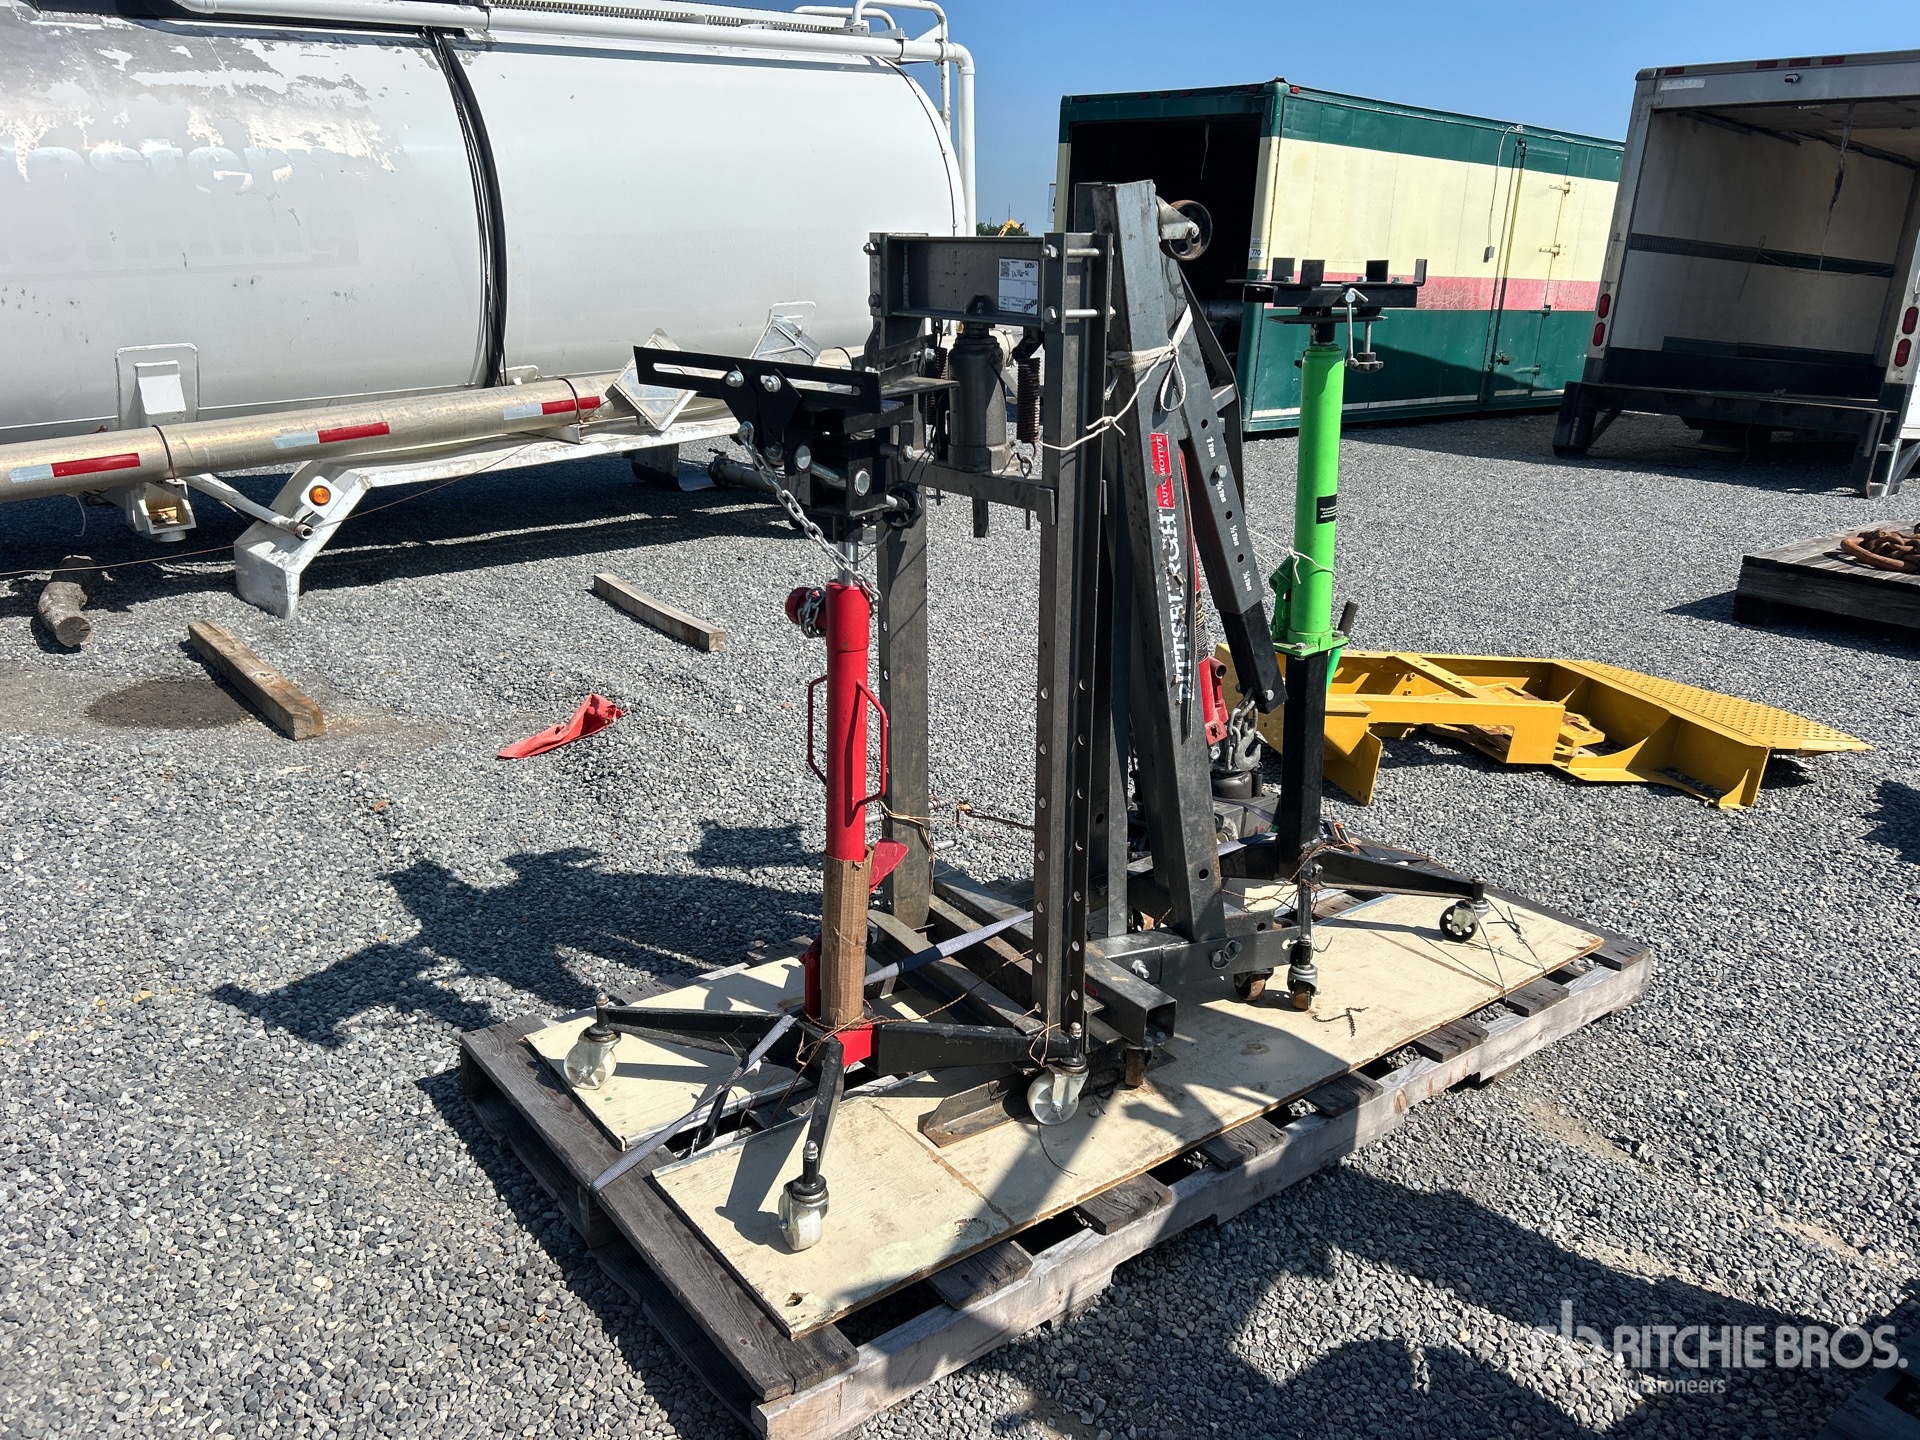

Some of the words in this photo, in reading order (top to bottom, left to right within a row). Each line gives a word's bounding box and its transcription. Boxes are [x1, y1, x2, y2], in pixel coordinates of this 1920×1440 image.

[1207, 443, 1216, 458] Ton
[1217, 488, 1227, 503] Ton
[1231, 532, 1240, 547] Ton
[1244, 578, 1253, 592] Ton
